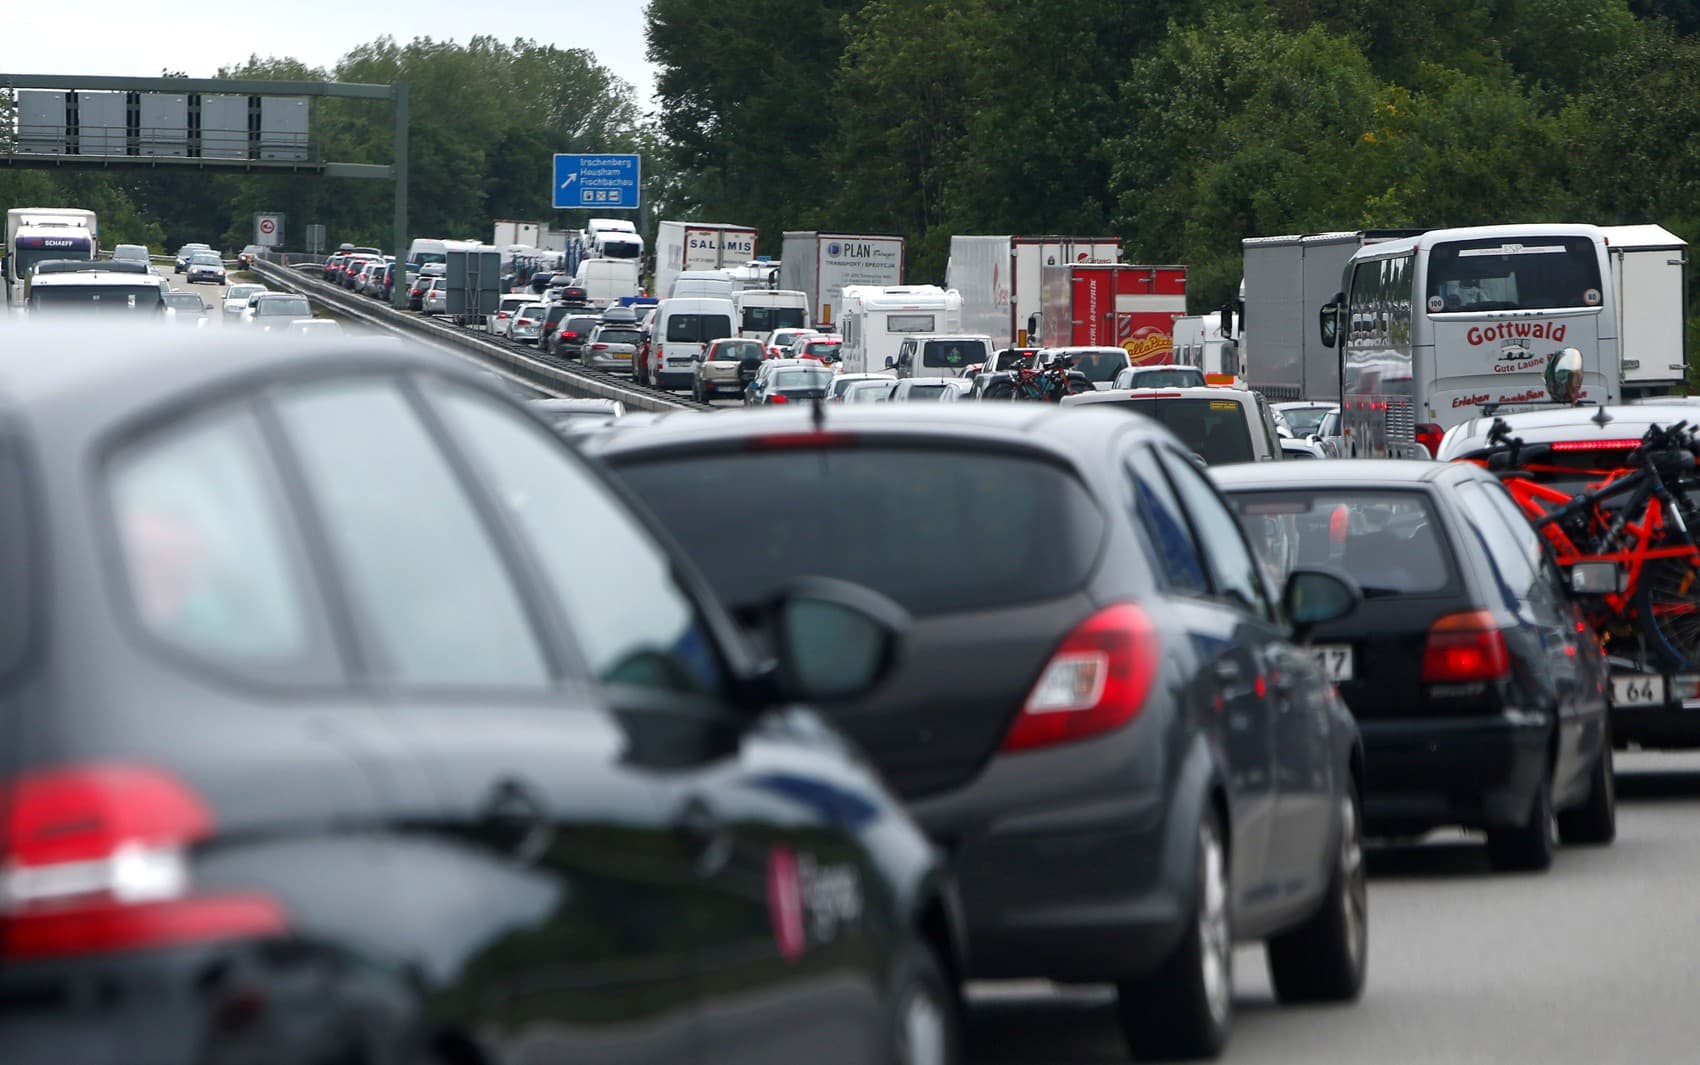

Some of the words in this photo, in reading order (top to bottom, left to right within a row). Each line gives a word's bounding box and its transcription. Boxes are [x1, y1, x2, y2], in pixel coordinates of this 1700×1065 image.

[580, 158, 631, 168] Irschenberg
[580, 168, 620, 176] Hausham
[580, 177, 633, 186] Fischbachau
[690, 239, 751, 251] SALAMIS
[843, 243, 870, 258] PLAN
[1467, 322, 1566, 346] Gottwald
[1494, 364, 1515, 373] Gute
[1517, 357, 1544, 370] Laune
[1452, 393, 1489, 408] Erleben
[1626, 680, 1654, 702] 64
